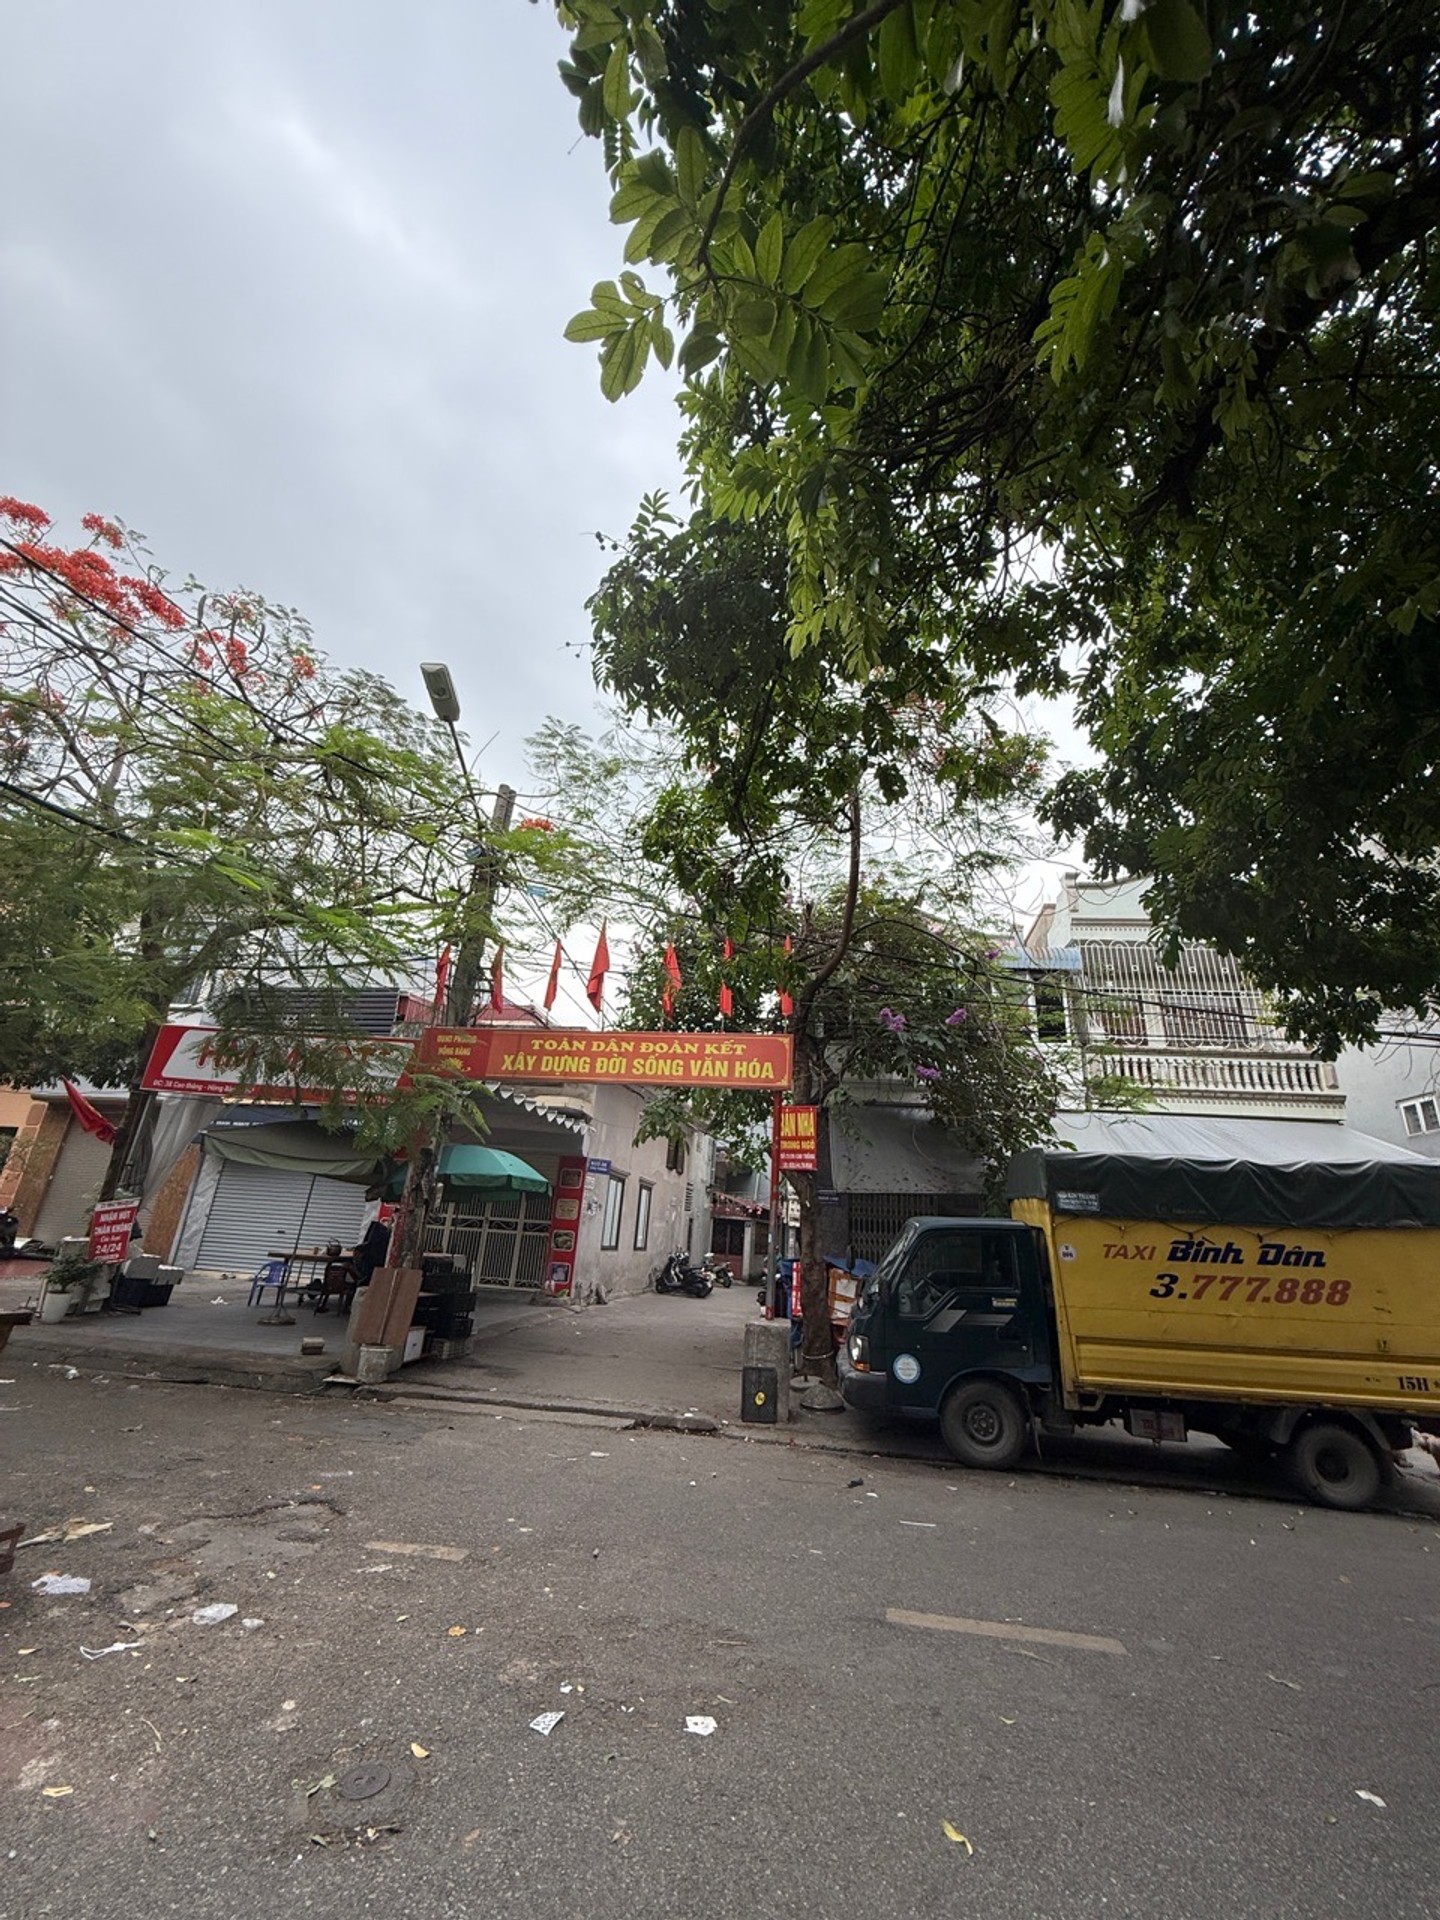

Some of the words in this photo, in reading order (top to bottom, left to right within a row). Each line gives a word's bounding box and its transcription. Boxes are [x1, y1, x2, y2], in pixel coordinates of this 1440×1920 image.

[531, 1037, 586, 1051] TOÀN
[592, 1038, 635, 1052] DÂN
[639, 1039, 699, 1054] ĐOÀN
[704, 1040, 747, 1056] KẾT
[501, 1051, 536, 1071] XÂY
[541, 1053, 590, 1075] DỰNG
[596, 1053, 627, 1074] ĐỜI
[632, 1053, 684, 1076] SỐNG
[690, 1057, 729, 1077] VĂN
[734, 1058, 775, 1079] HÓA
[95, 1242, 122, 1254] 24/24
[1103, 1243, 1157, 1261] TAXI
[1167, 1236, 1244, 1265] Bình
[1256, 1243, 1327, 1268] Dân
[1149, 1273, 1352, 1306] 3.777.888
